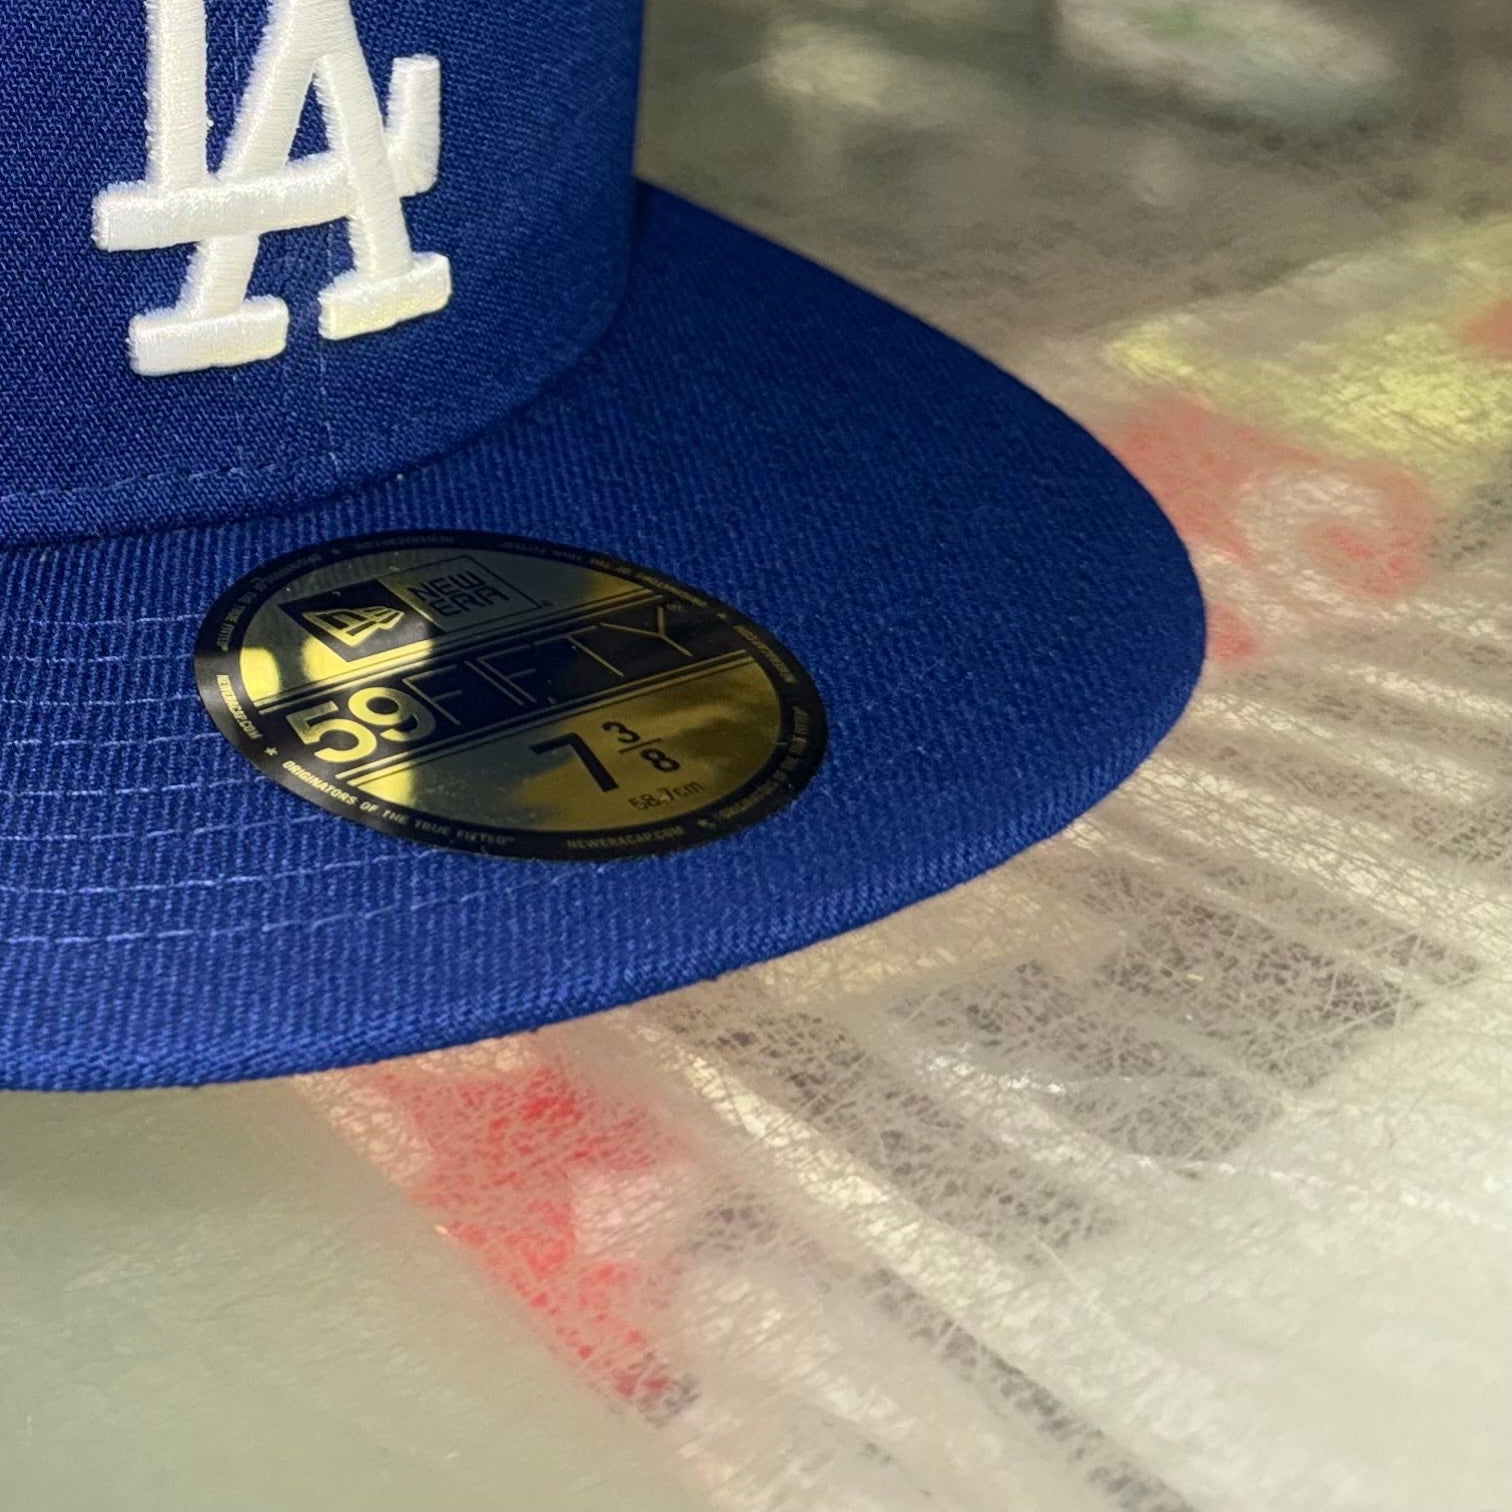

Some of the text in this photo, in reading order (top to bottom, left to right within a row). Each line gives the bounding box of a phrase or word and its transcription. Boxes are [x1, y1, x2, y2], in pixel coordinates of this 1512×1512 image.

[407, 570, 487, 603] NEW
[429, 586, 510, 617] ERA
[531, 732, 619, 792] 7
[281, 759, 358, 807] ORIGINATORS
[359, 800, 379, 815] OF
[383, 809, 408, 825] THE
[415, 820, 452, 837] TRUE
